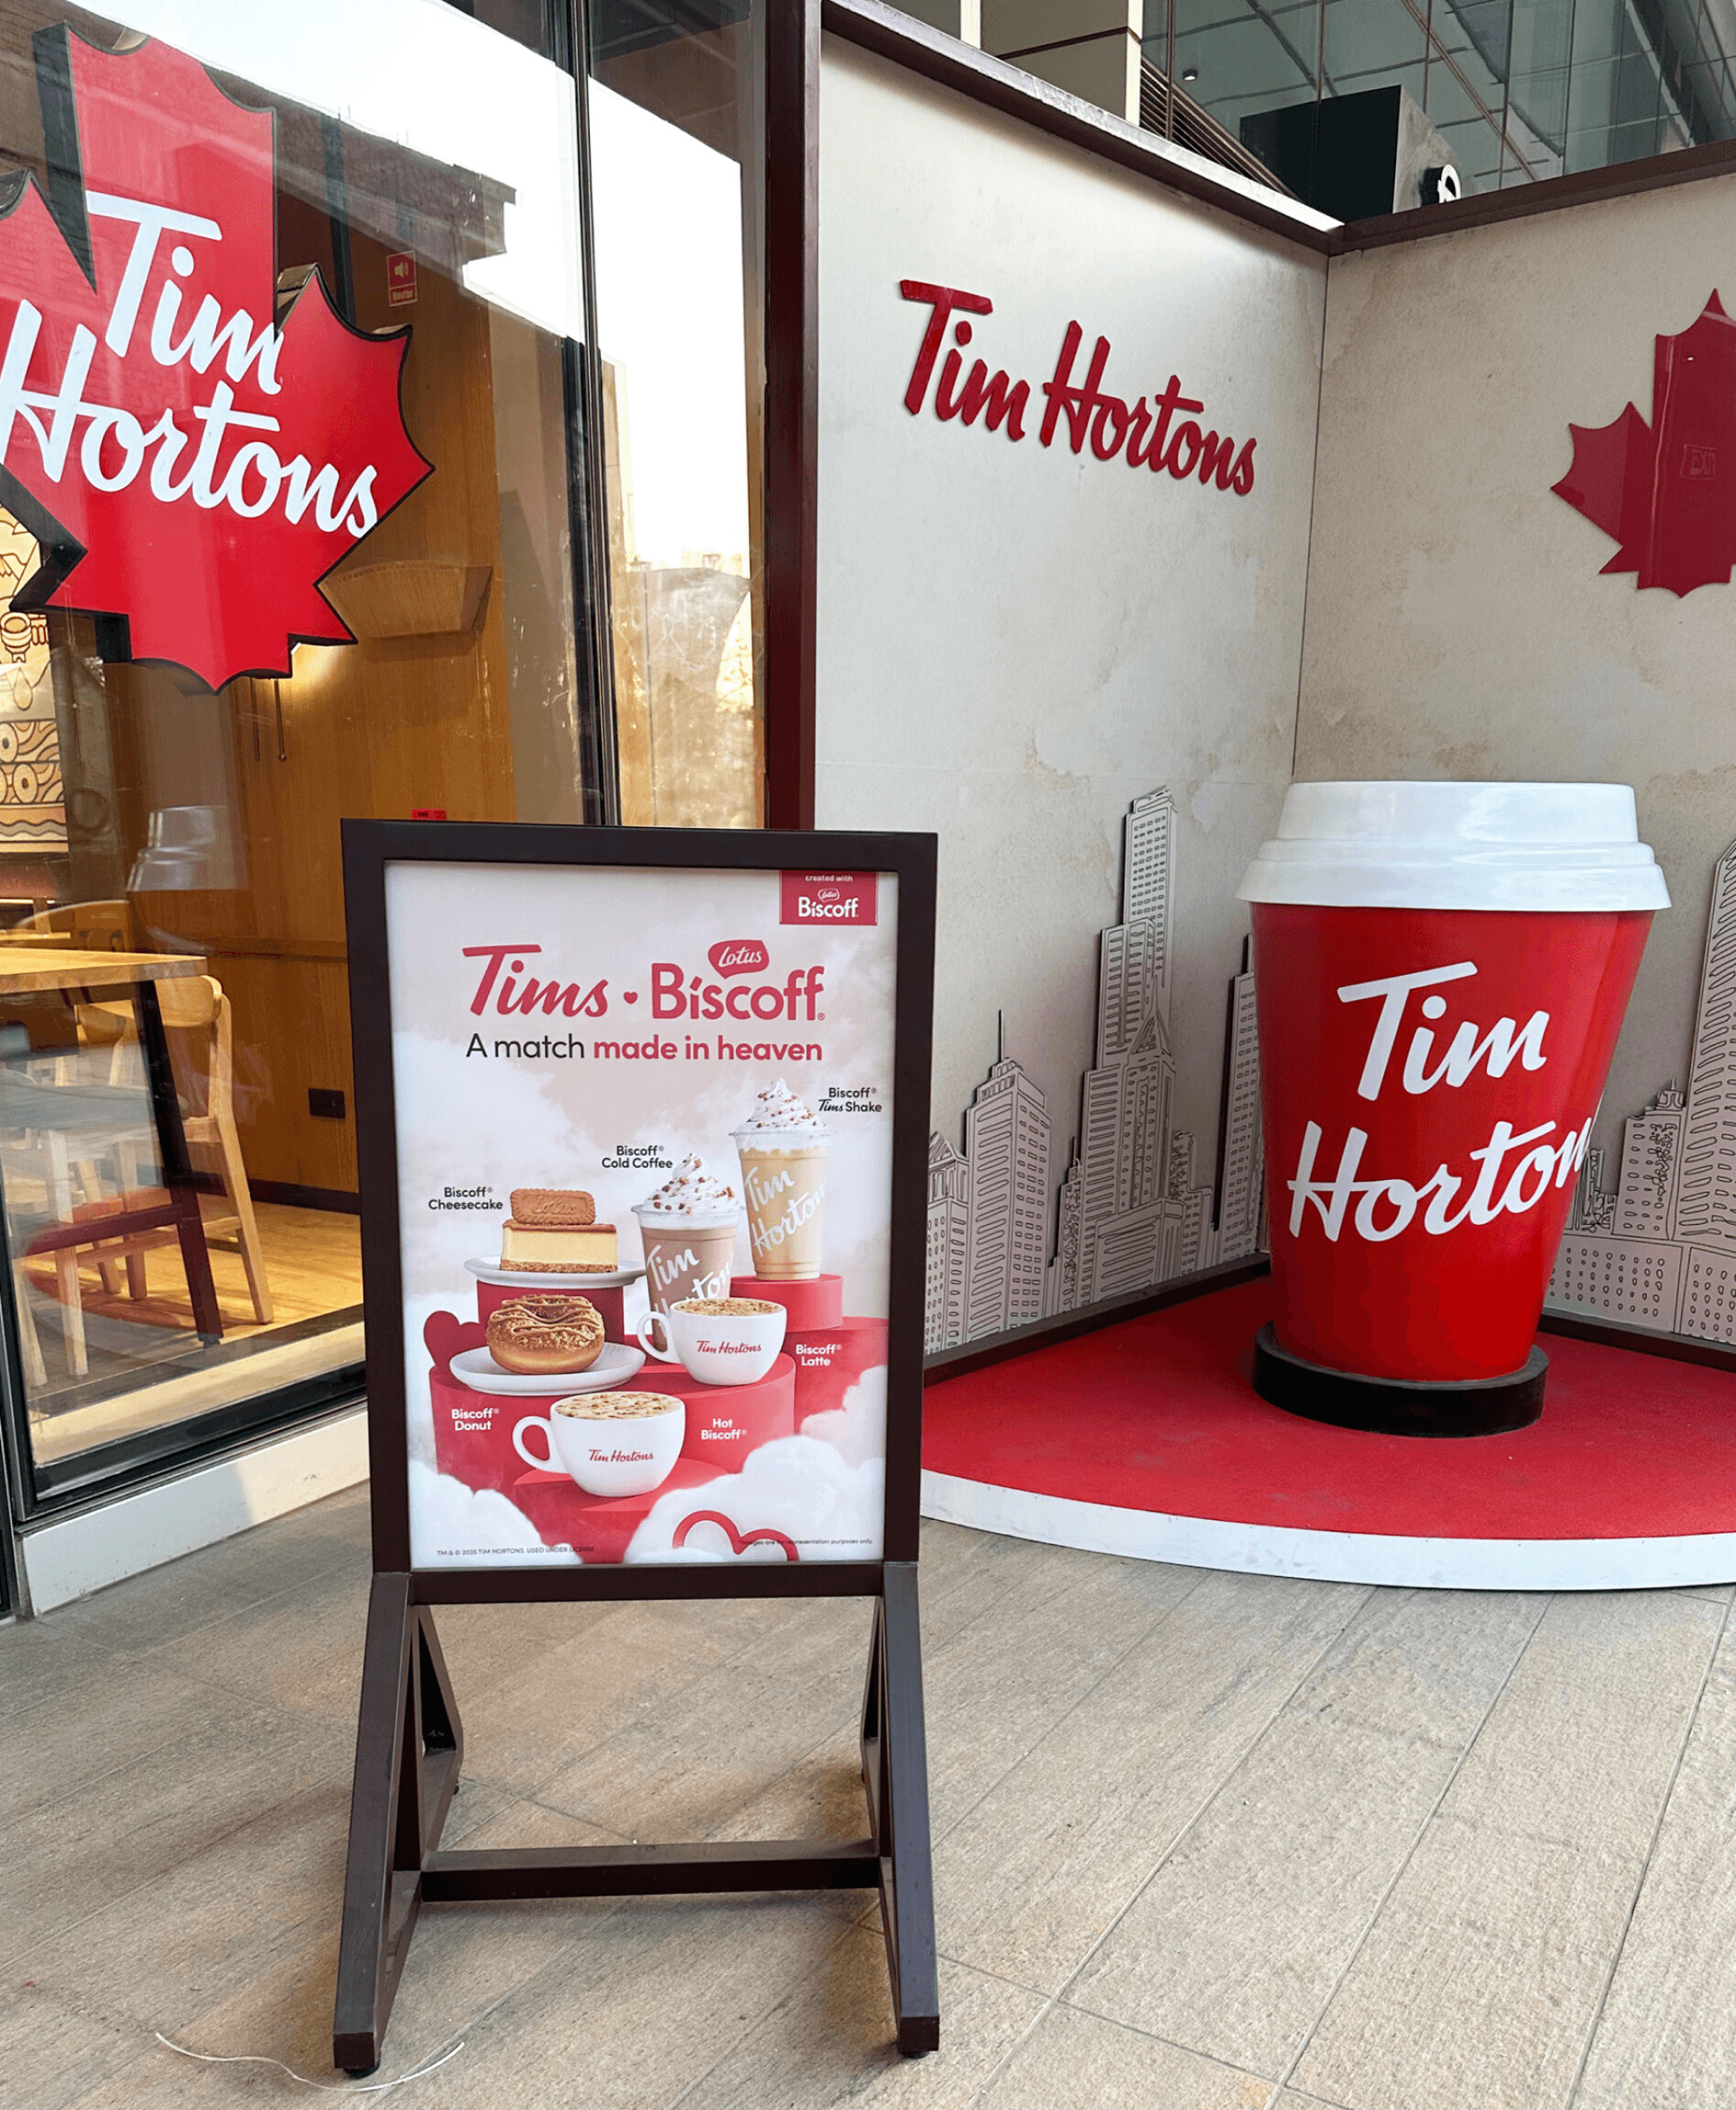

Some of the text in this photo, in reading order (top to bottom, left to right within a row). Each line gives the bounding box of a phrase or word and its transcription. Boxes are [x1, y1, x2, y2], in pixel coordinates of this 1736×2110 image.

[86, 190, 284, 395] Tim
[899, 279, 1257, 496] Tim Hortons
[0, 299, 377, 539] Hortons
[836, 874, 853, 882] with
[718, 947, 763, 968] Lotus
[462, 944, 609, 1017] Tims
[1337, 960, 1550, 1101] Tim
[465, 1033, 822, 1061] A match made in heaven
[818, 1099, 882, 1112] Tims Shake
[602, 1157, 673, 1168] Cold Coffee
[745, 1166, 795, 1211] Tim
[428, 1199, 504, 1210] Cheesecake
[646, 1244, 700, 1292] Tim
[697, 1340, 761, 1354] Tim Hortons
[801, 1356, 831, 1366] Latte
[455, 1421, 492, 1430] Donut
[713, 1418, 732, 1428] Hot
[588, 1449, 654, 1462] Tim Hortons
